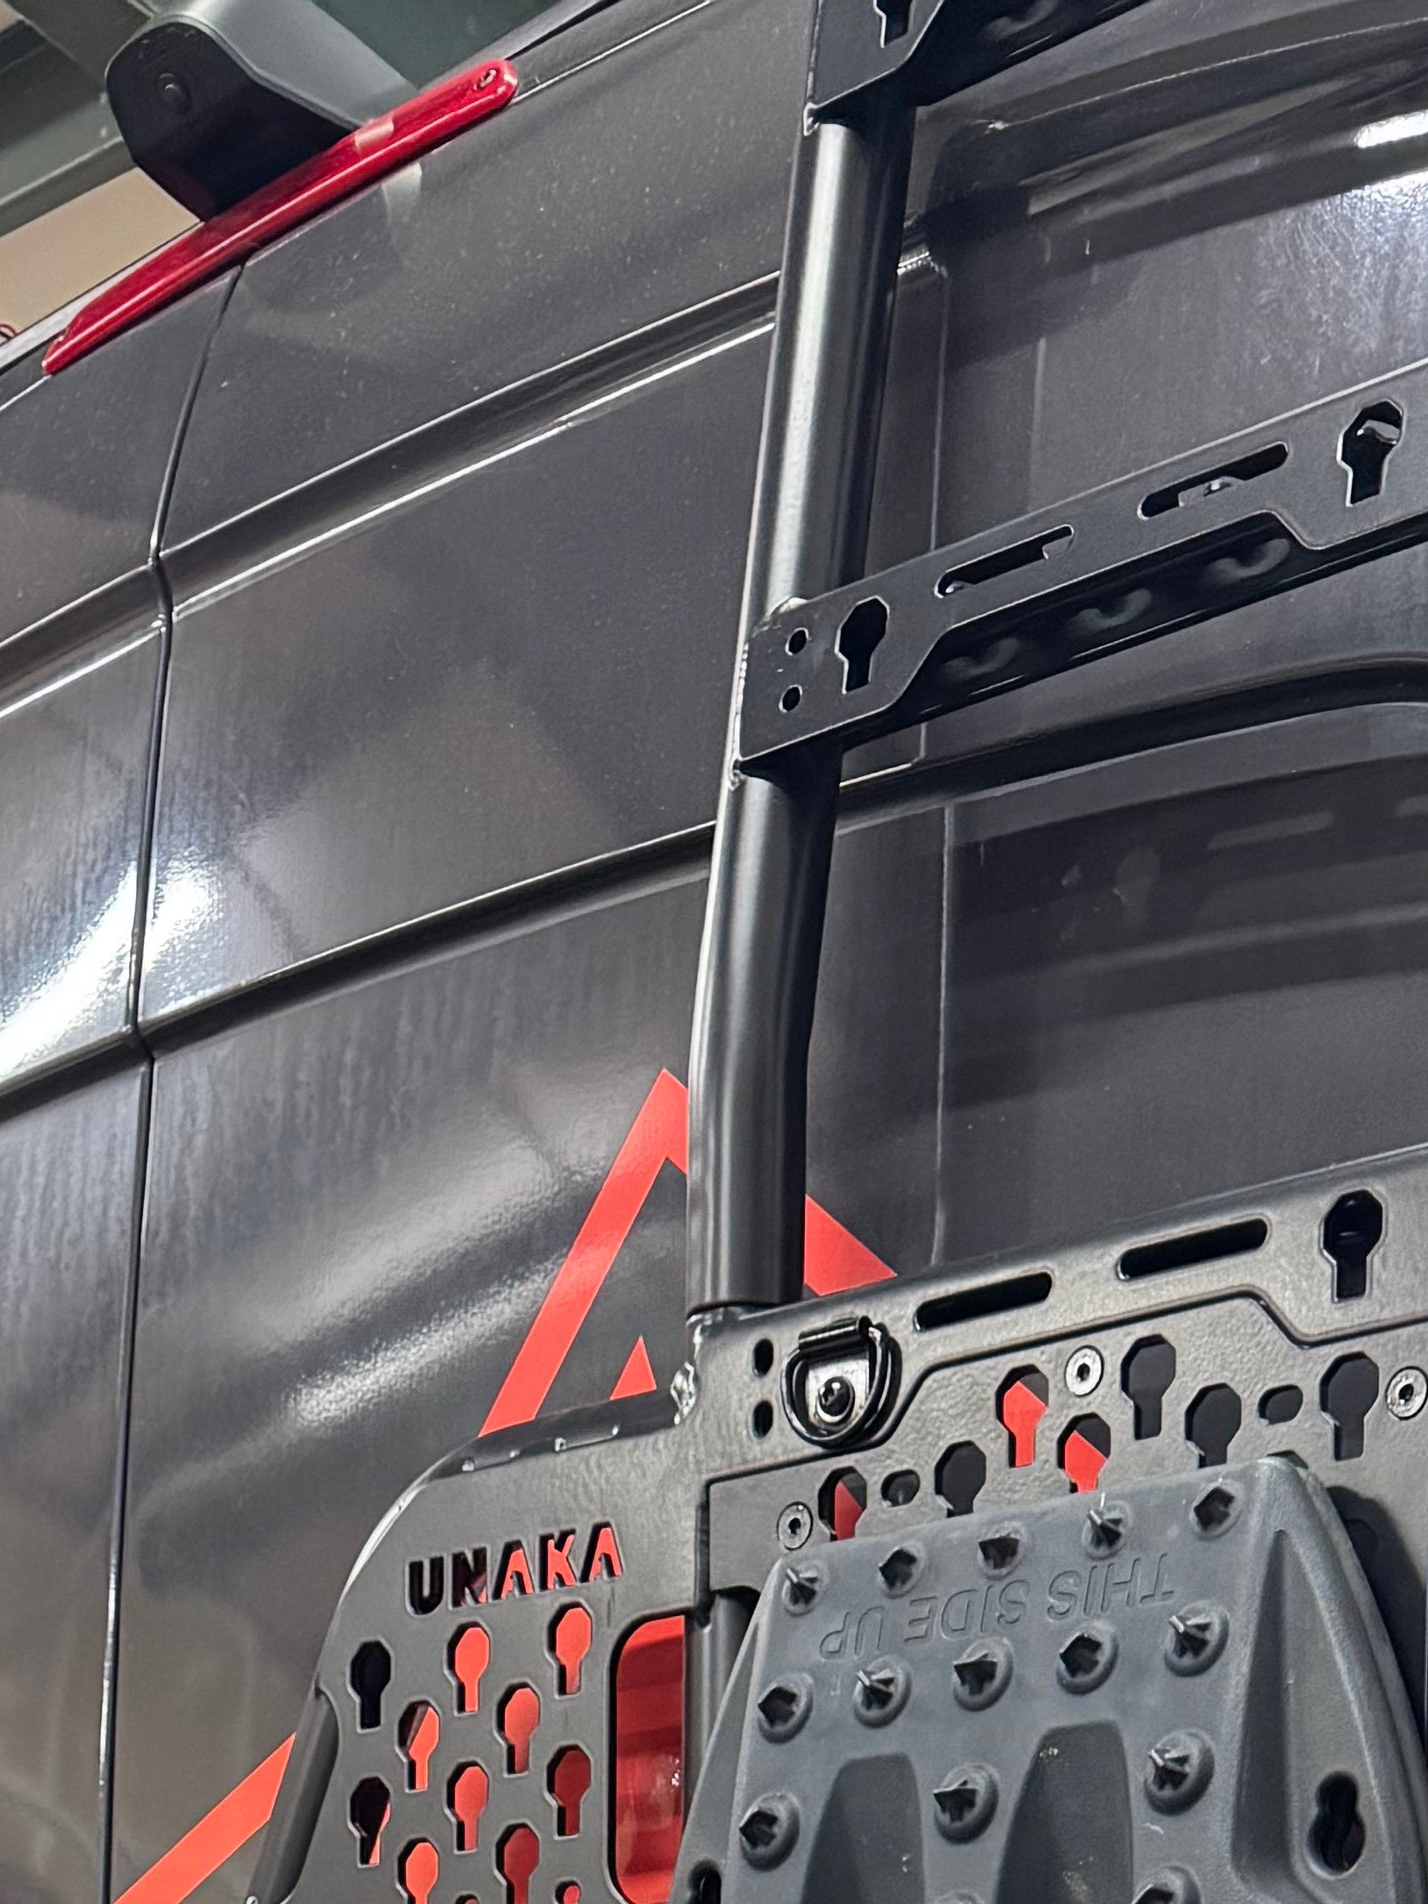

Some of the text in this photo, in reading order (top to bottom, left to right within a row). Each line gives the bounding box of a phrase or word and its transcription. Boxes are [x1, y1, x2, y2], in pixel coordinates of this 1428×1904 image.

[405, 1520, 625, 1617] UNAKA
[817, 1552, 1175, 1661] THIS SIDE UP
